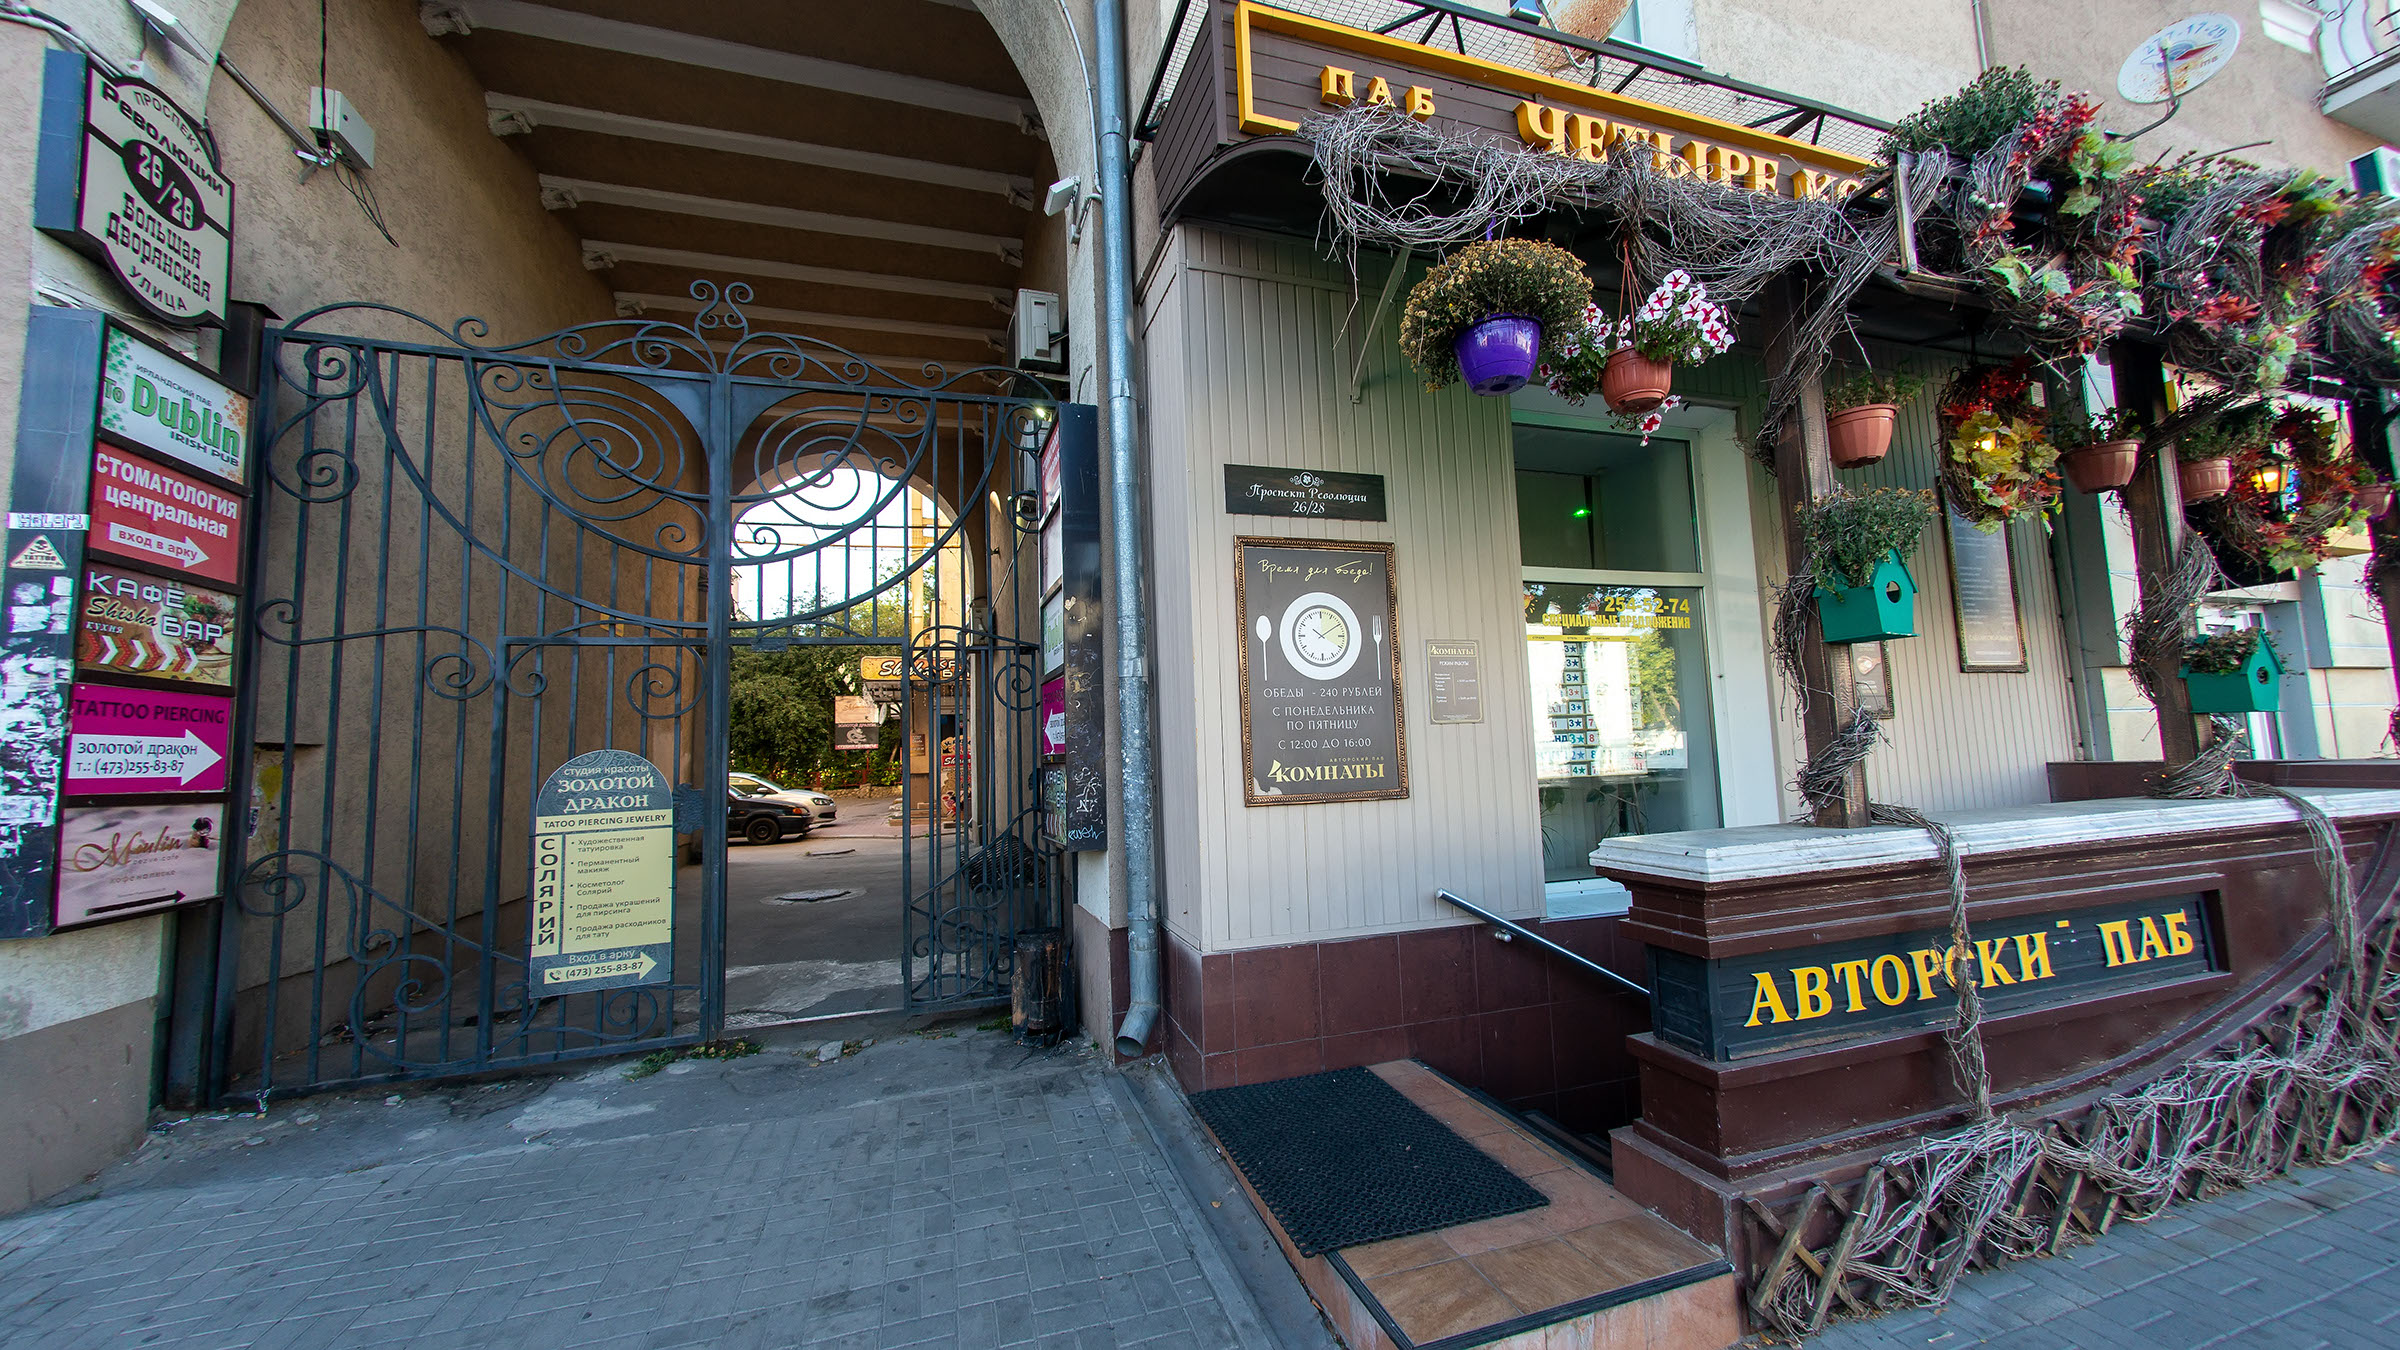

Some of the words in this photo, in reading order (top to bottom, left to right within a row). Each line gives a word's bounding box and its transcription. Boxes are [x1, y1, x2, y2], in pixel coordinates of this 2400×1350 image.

[1319, 65, 1435, 123] ПАБ
[133, 90, 202, 153] ПРОСПЕКТ
[137, 143, 195, 230] 26/28
[128, 265, 188, 313] УЛИЦА
[136, 363, 195, 398] ИРЛАНДСКИЙ
[195, 393, 213, 407] ПАБ
[131, 375, 241, 458] Dublin
[170, 431, 208, 454] IRISH
[211, 451, 240, 467] PUB
[96, 453, 238, 520] СТОМАТОЛОГИЯ
[1246, 483, 1306, 502] Проспект
[1308, 488, 1368, 504] Революции
[105, 485, 228, 538] центральная
[1292, 501, 1326, 516] 26/28
[118, 530, 153, 550] вход
[157, 538, 165, 550] в
[167, 543, 199, 562] арку
[1257, 559, 1300, 583] Время
[1304, 566, 1328, 582] для
[87, 571, 187, 609] КАФЕ
[86, 596, 159, 627] Shisha
[1604, 596, 1691, 614] 254-52-74
[85, 620, 124, 634] кухня
[162, 614, 224, 641] БАР
[1542, 614, 1618, 628] СПЕЦИАЛЬНЫЕ
[1619, 615, 1691, 629] ПРЕДЛОЖЕНИЯ
[1263, 687, 1305, 698] ОБЕДЫ
[1320, 687, 1339, 697] 240
[1342, 686, 1383, 697] РУБЛЕЙ
[75, 699, 149, 719] TATTOO
[153, 704, 225, 724] PIERCING
[1272, 706, 1281, 717] С
[1284, 705, 1375, 717] ПОНЕДЕЛЬНИКА
[1286, 720, 1304, 731] ПО
[1308, 719, 1360, 731] ПЯТНИЦУ
[77, 741, 144, 755] золотой
[147, 742, 198, 758] дракон
[1278, 740, 1286, 750] С
[1290, 739, 1318, 749] 12:00
[1321, 738, 1340, 750] ДО
[1344, 737, 1372, 748] 16:00
[95, 758, 185, 776] (473)255-83-87
[563, 767, 601, 777] студия
[604, 764, 650, 775] красоты
[557, 772, 655, 793] ЗОЛОТОЙ
[563, 794, 649, 814] ДРАКОН
[543, 820, 576, 829] TATOO
[578, 817, 623, 827] PIERCING
[625, 814, 667, 824] JEWELRY
[577, 835, 645, 847] Художественная
[577, 844, 624, 853] татуировка
[577, 857, 640, 868] Перманентный
[577, 866, 610, 874] макияж
[538, 838, 559, 946] СОЛЯРИЙ
[576, 888, 612, 896] Солярий
[577, 880, 625, 889] Косметолог
[575, 910, 592, 918] для
[593, 908, 631, 917] пирсинга
[576, 902, 614, 912] Продажа
[615, 897, 661, 908] украшений
[575, 924, 613, 934] Продажа
[614, 918, 667, 929] расходников
[575, 933, 591, 941] для
[592, 931, 610, 939] тату
[568, 954, 597, 965] Вход
[609, 950, 636, 960] арку
[565, 966, 592, 979] (473)
[594, 961, 644, 974] 255-83-87
[1744, 920, 2070, 1027] АВТОРСКИ
[2097, 910, 2195, 967] ПАБ
